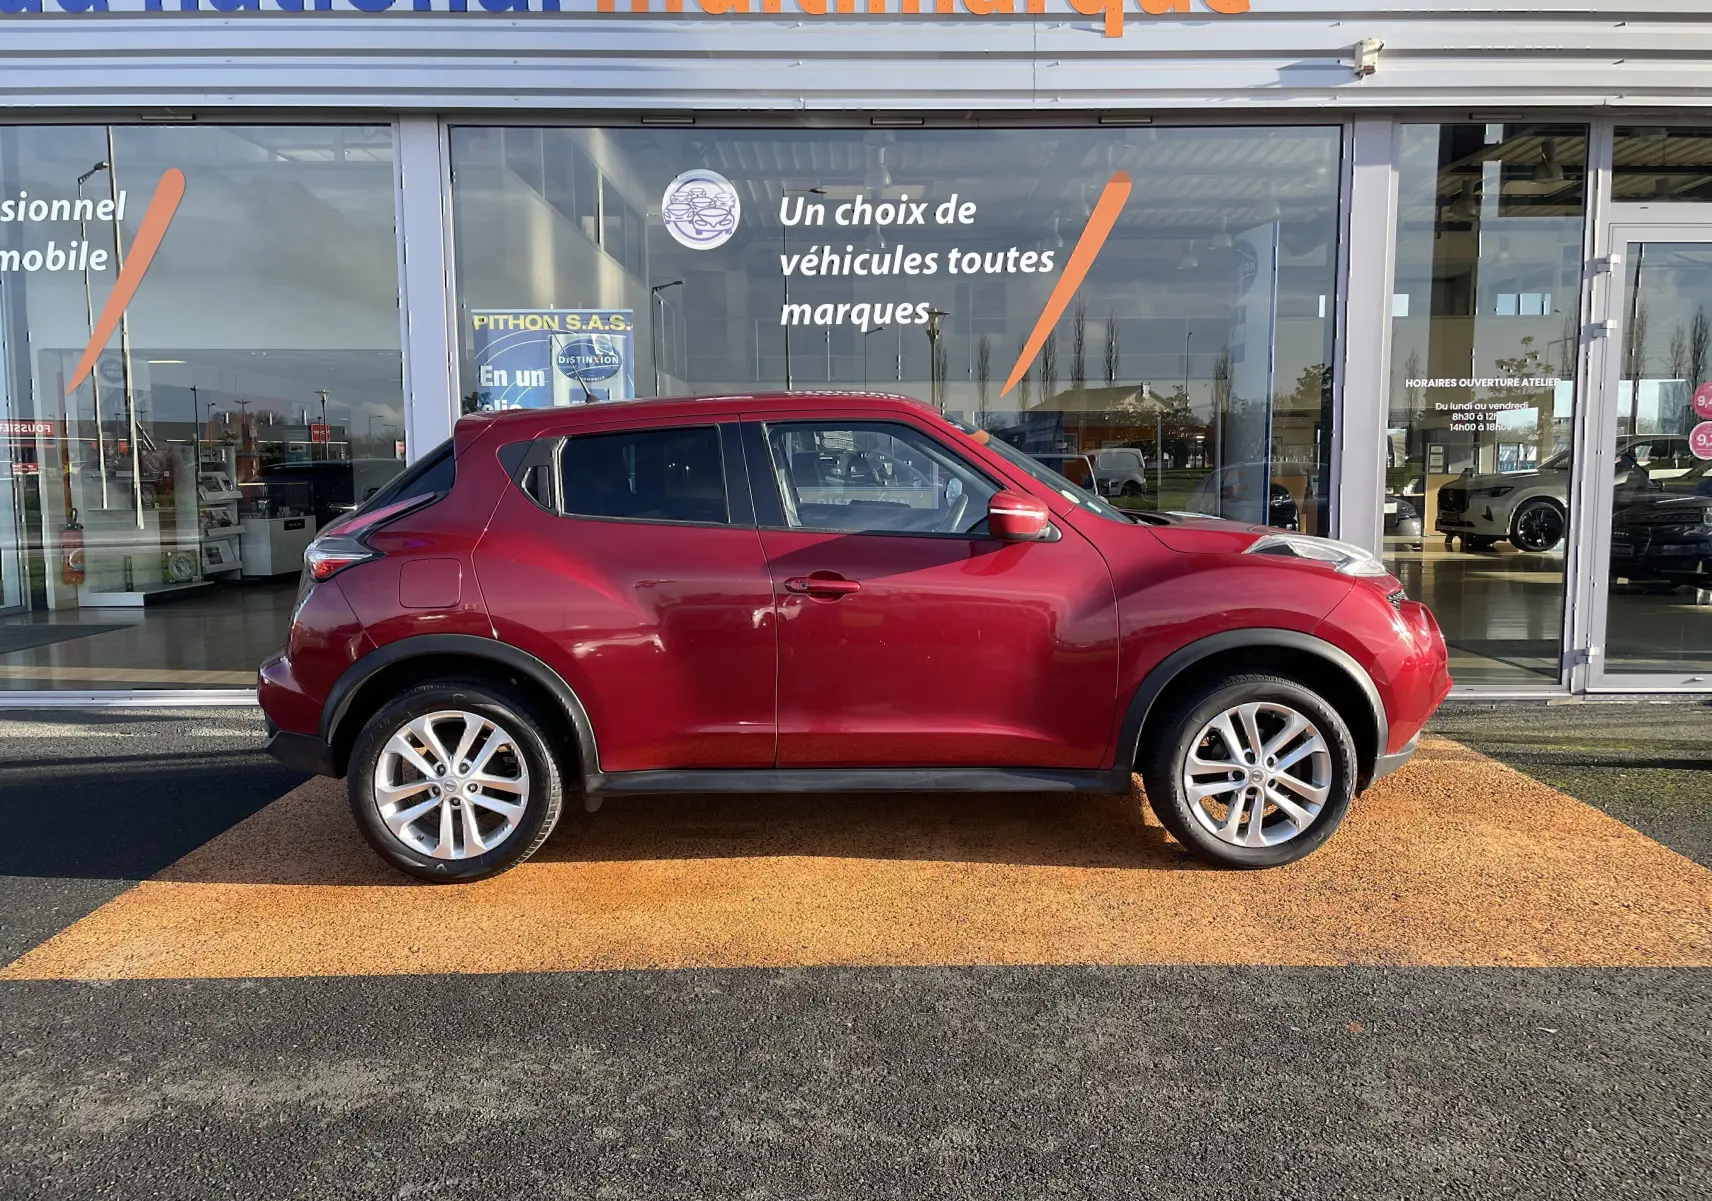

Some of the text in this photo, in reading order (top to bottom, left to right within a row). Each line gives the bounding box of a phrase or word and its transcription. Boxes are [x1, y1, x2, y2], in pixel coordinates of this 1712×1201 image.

[0, 189, 128, 223] sionnel
[780, 193, 977, 225] Un choix de
[0, 242, 108, 274] mobile
[780, 244, 1055, 275] véhicules toutes
[473, 314, 632, 330] PITHON S.A.S.
[780, 301, 930, 333] marques
[558, 354, 620, 365] DISTINXION
[481, 365, 545, 387] En un
[1405, 378, 1457, 388] HORAIRES
[1458, 378, 1519, 388] OUVERTURE
[1435, 402, 1448, 410] Du
[1449, 402, 1473, 410] lundi
[1488, 402, 1529, 410] vendredi
[1452, 412, 1475, 421] 8h30
[1476, 412, 1484, 421] à
[1449, 423, 1476, 431] 14h00
[1477, 422, 1484, 431] à
